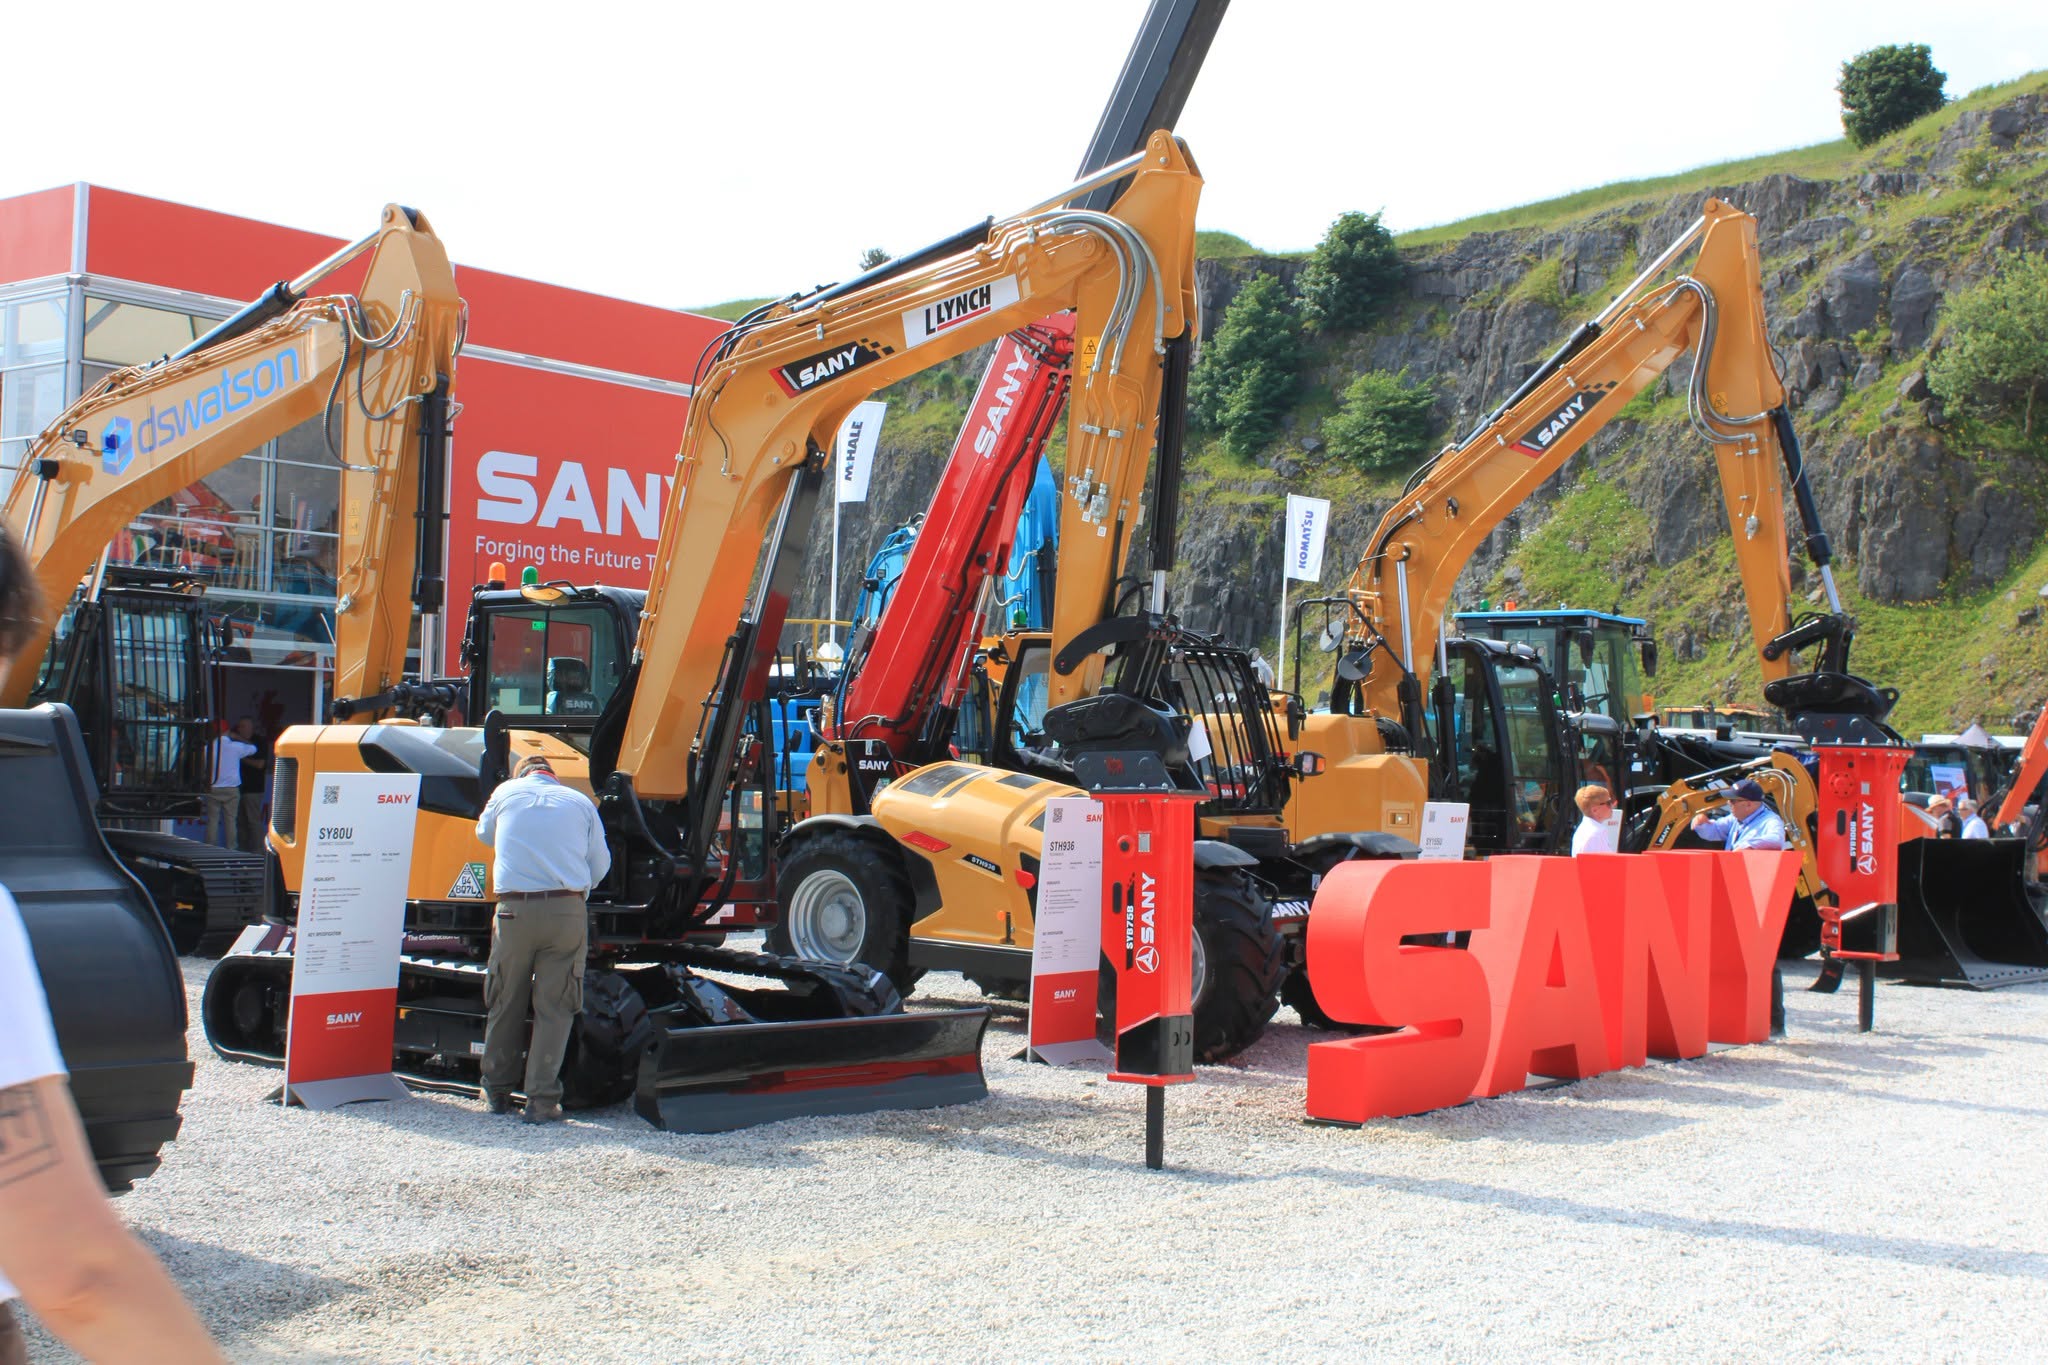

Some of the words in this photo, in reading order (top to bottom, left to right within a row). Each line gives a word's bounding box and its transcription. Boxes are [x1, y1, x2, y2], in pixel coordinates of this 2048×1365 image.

[798, 346, 858, 388] SANY
[137, 347, 300, 454] dswatson
[974, 344, 1029, 459] SANY
[1537, 395, 1584, 446] SANY
[476, 535, 546, 566] Forging
[550, 543, 580, 564] the
[585, 547, 642, 570] Future
[1298, 510, 1314, 569] KOMATSU
[565, 699, 594, 709] SANY
[858, 759, 890, 771] SANY
[377, 794, 412, 804] SANY
[1086, 814, 1102, 822] SAN
[1861, 803, 1874, 854] SANY
[318, 827, 353, 840] SY80U
[1049, 841, 1075, 852] STH936
[971, 856, 996, 871] STH936
[1140, 872, 1156, 944] SANY
[1271, 901, 1311, 918] SANY
[1126, 905, 1134, 950] SYB75B
[1054, 989, 1077, 1000] SANY
[1305, 850, 1801, 1123] SANY
[326, 1012, 362, 1025] SANY
